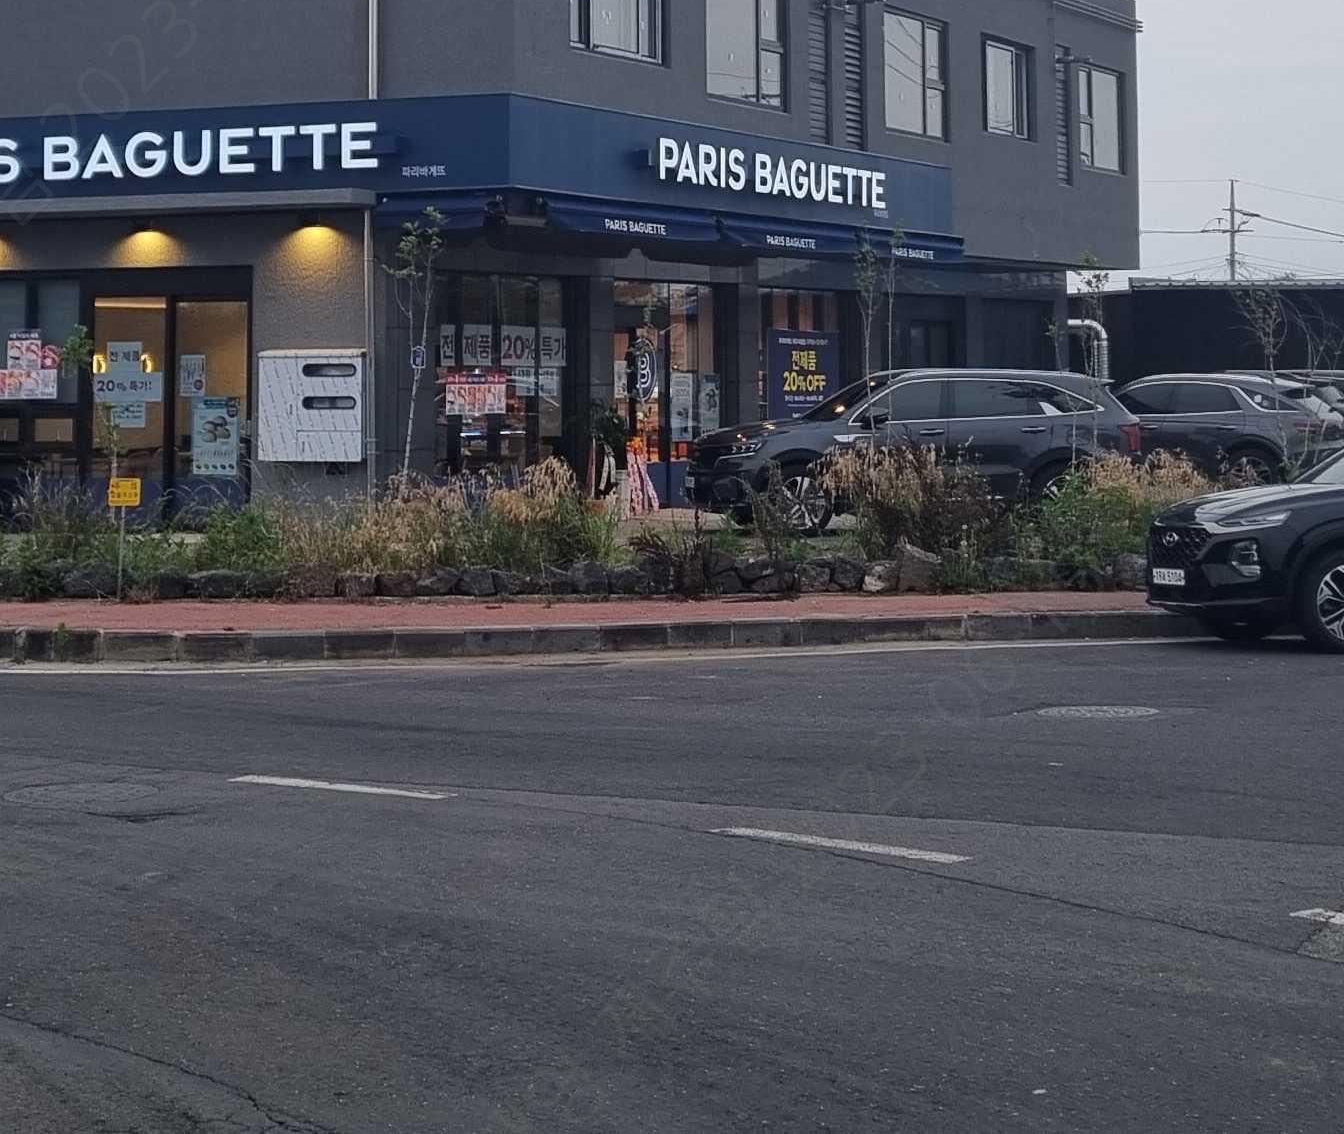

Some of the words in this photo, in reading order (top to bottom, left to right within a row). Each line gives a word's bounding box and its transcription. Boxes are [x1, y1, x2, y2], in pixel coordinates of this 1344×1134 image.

[43, 120, 380, 181] BAGUETTE
[401, 164, 447, 178] 파리바게뜨
[659, 136, 746, 192] PARIS
[754, 152, 887, 209] BAGUETTE
[604, 219, 628, 232] PARIS
[629, 220, 666, 235] BAGUETTE
[766, 235, 785, 246] PARIS
[785, 236, 816, 249] BAGUETTE
[908, 248, 934, 260] BAGUETTE
[441, 335, 454, 360] 전
[463, 334, 491, 360] 제품
[502, 334, 536, 361] 20%
[540, 336, 567, 361] 특가
[791, 349, 817, 371] 전제품
